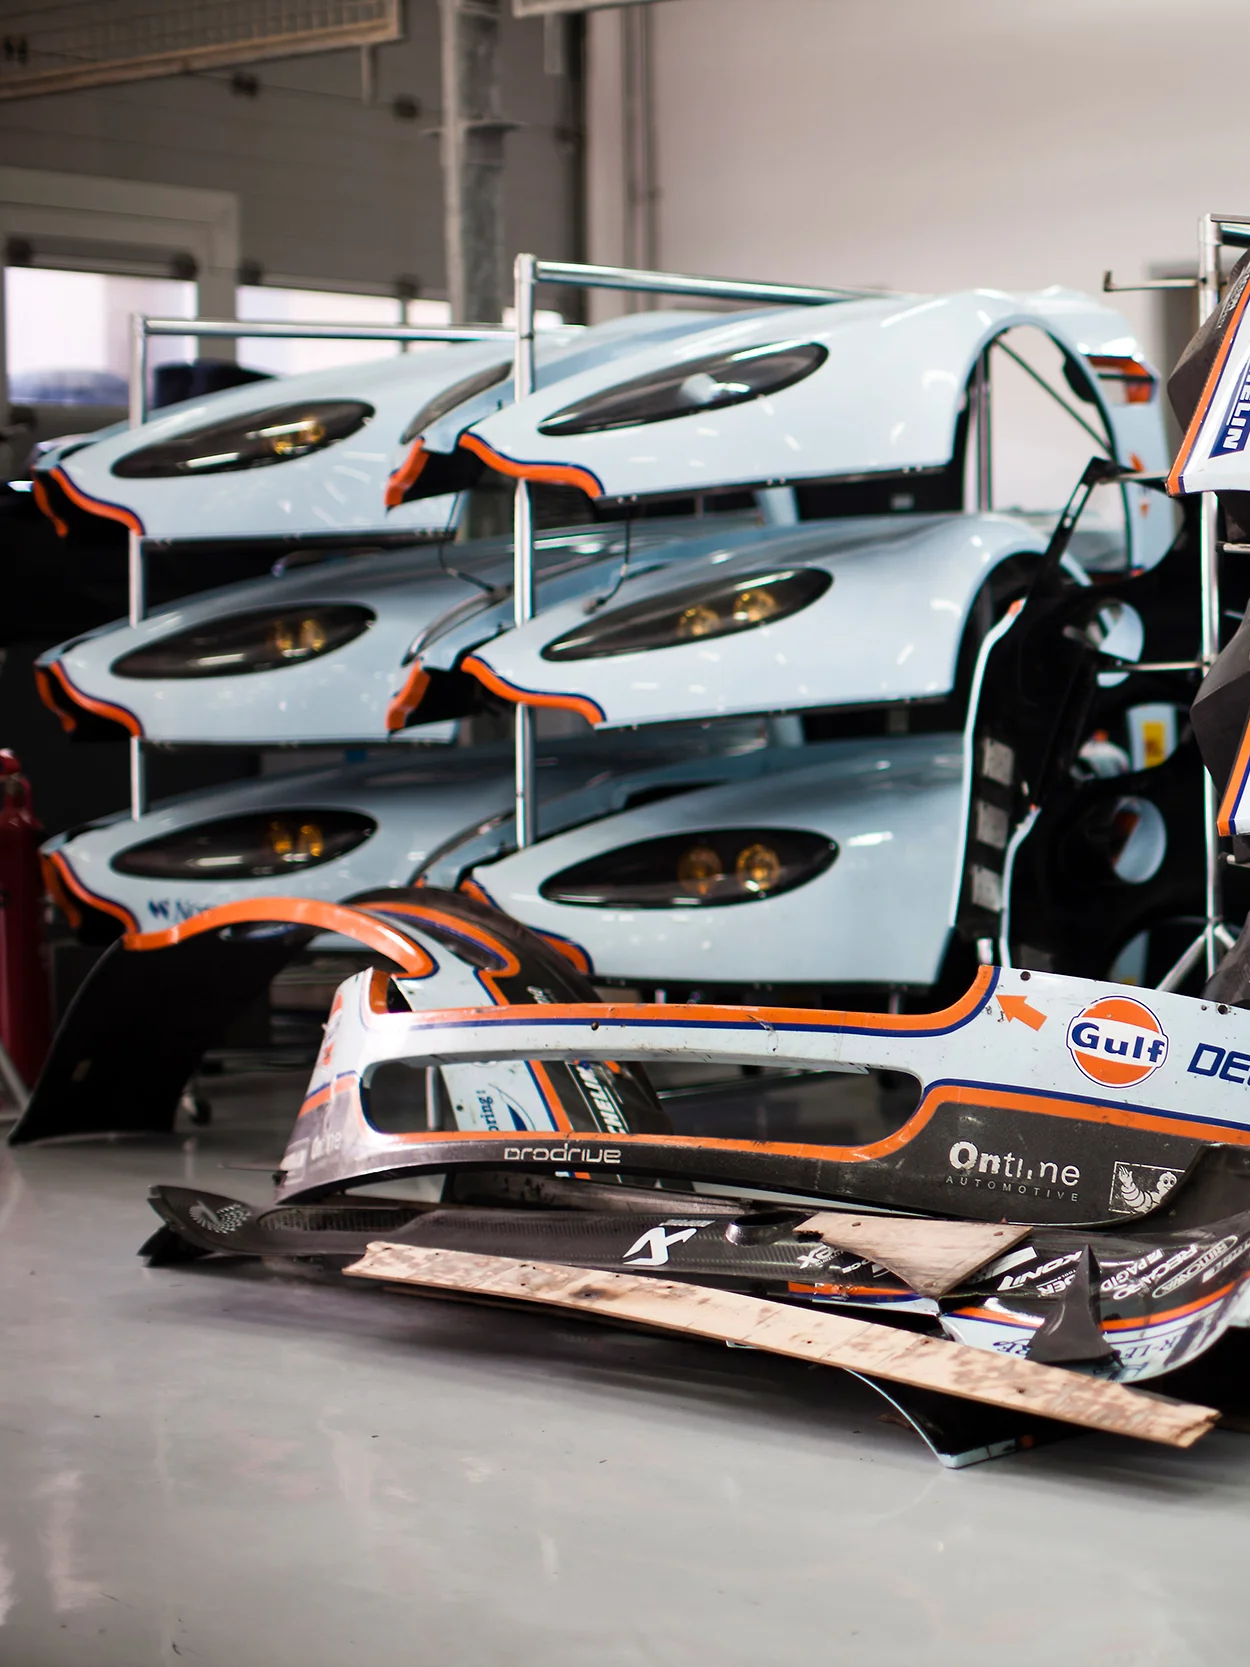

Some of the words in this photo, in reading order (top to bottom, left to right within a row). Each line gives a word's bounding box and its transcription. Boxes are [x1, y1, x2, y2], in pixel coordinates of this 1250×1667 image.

[1071, 1022, 1165, 1064] Gulf
[946, 1175, 1079, 1203] AUTOMOTIVE
[1100, 1256, 1149, 1292] PAGID
